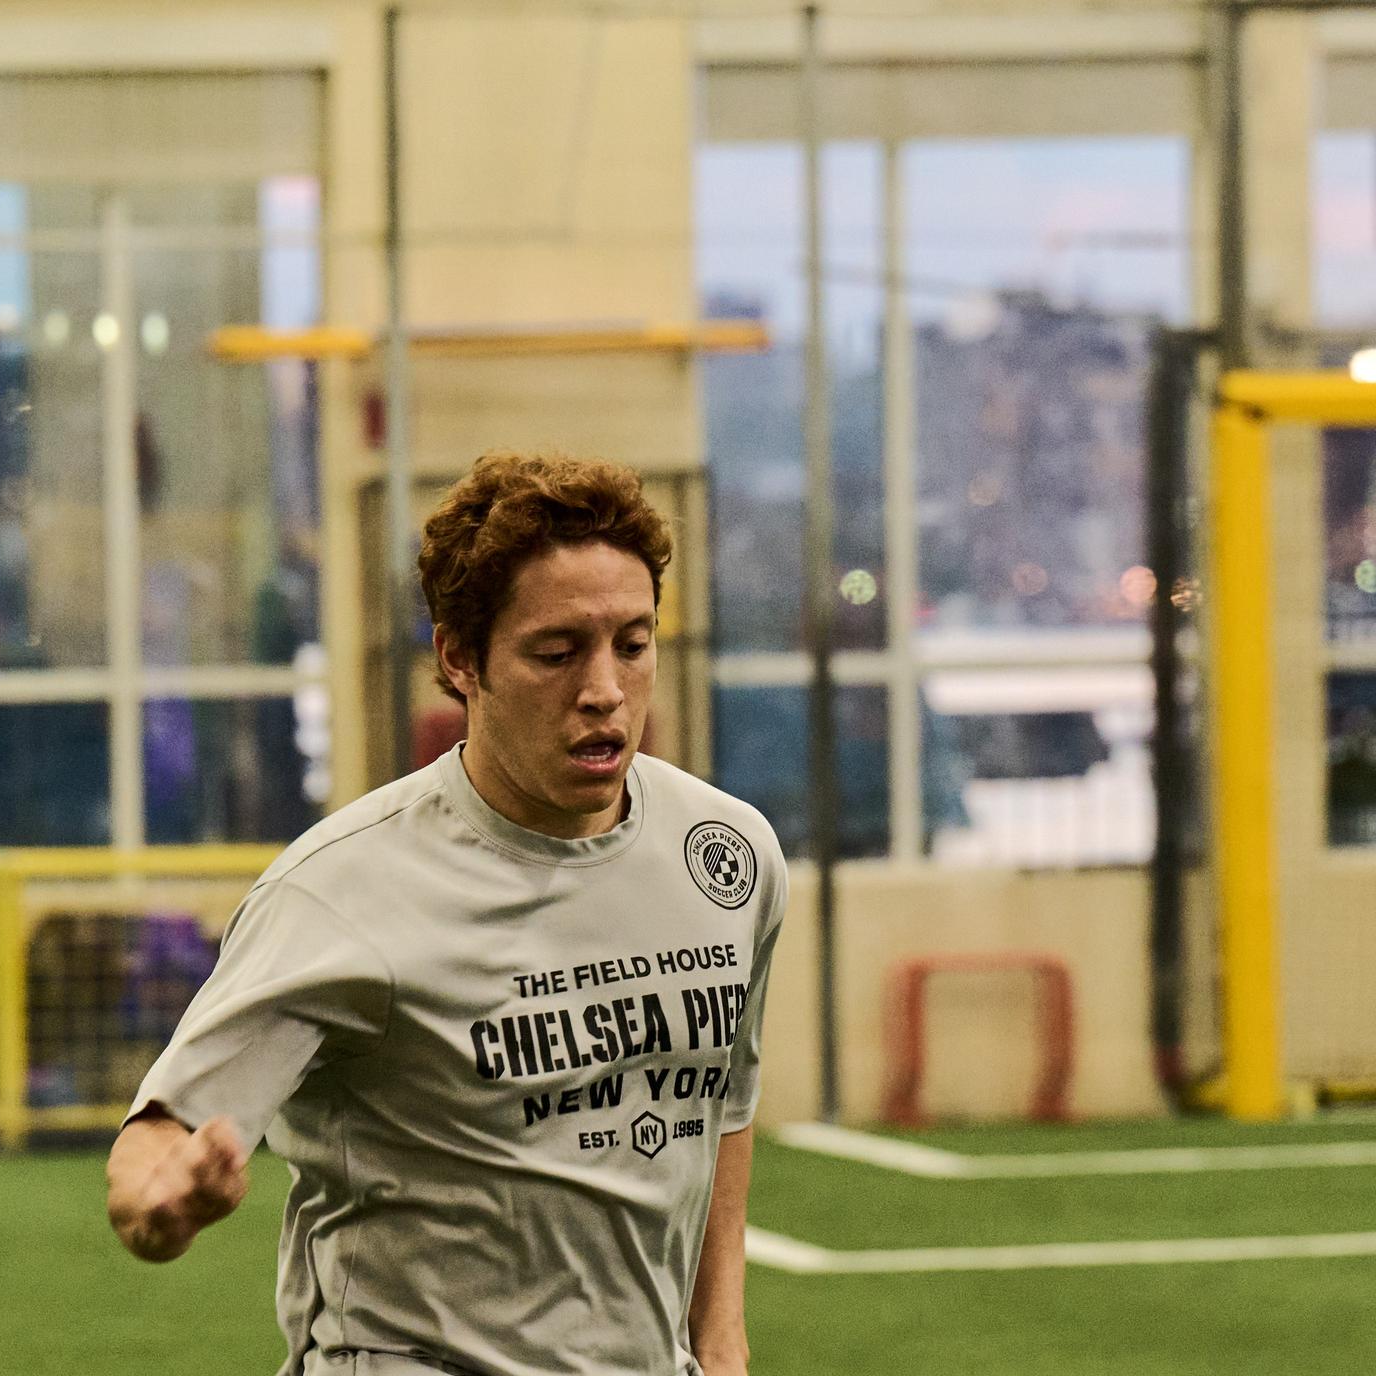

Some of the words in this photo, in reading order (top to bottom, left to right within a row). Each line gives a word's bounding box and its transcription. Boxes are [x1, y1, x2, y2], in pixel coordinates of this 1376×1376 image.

[692, 832, 717, 855] CHELSEA
[719, 833, 742, 852] PIERS
[707, 882, 733, 899] SOCCER
[733, 878, 748, 897] CLUB
[513, 970, 568, 998] THE
[573, 956, 651, 990] FIELD
[656, 944, 737, 975] HOUSE
[469, 993, 672, 1081] CHELSEA
[681, 981, 750, 1050] PIER
[523, 1073, 624, 1127] NEW
[578, 1129, 621, 1150] EST.
[640, 1124, 658, 1146] NY
[673, 1118, 704, 1140] 1995
